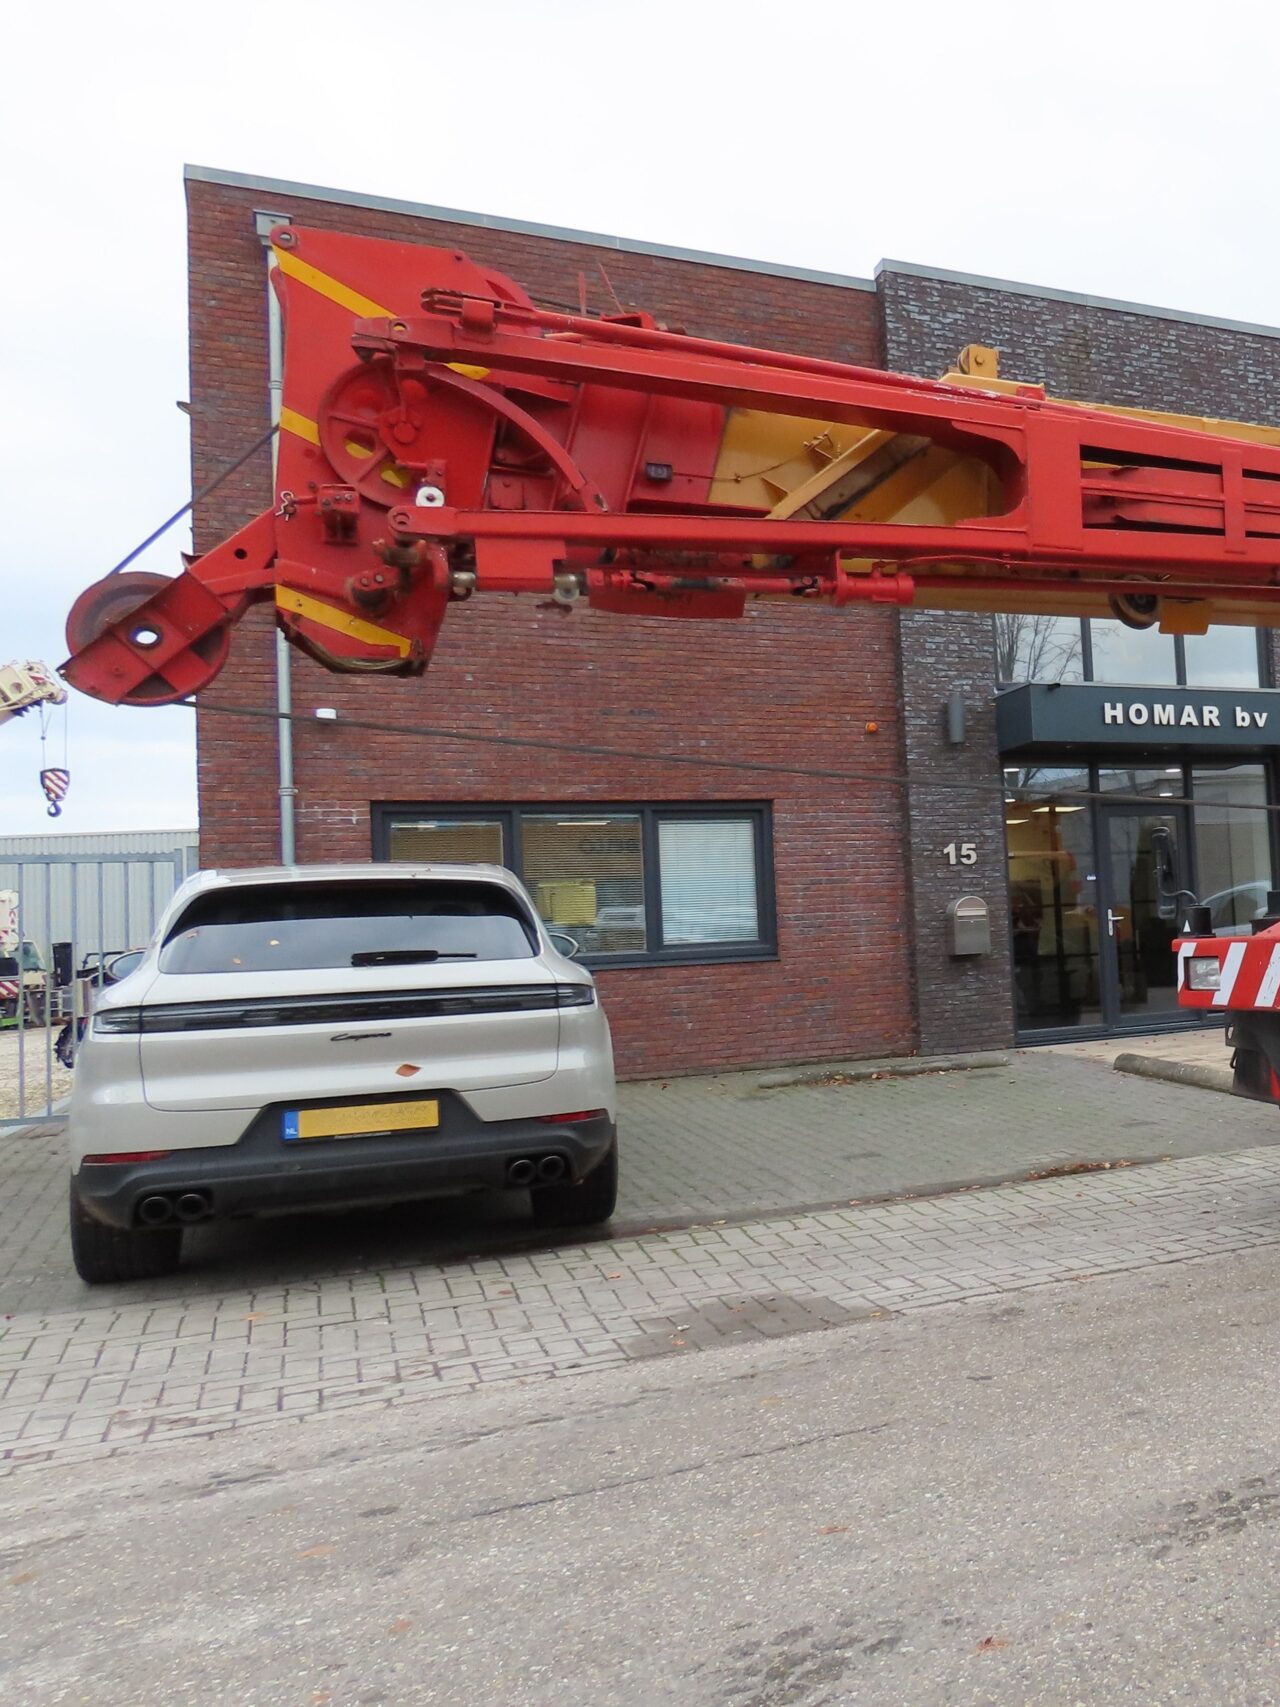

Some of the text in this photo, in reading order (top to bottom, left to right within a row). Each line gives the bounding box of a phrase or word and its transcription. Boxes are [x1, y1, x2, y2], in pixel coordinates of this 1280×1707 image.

[1104, 702, 1268, 727] HOMAR bv
[943, 843, 978, 865] 15
[285, 1127, 298, 1135] NL
